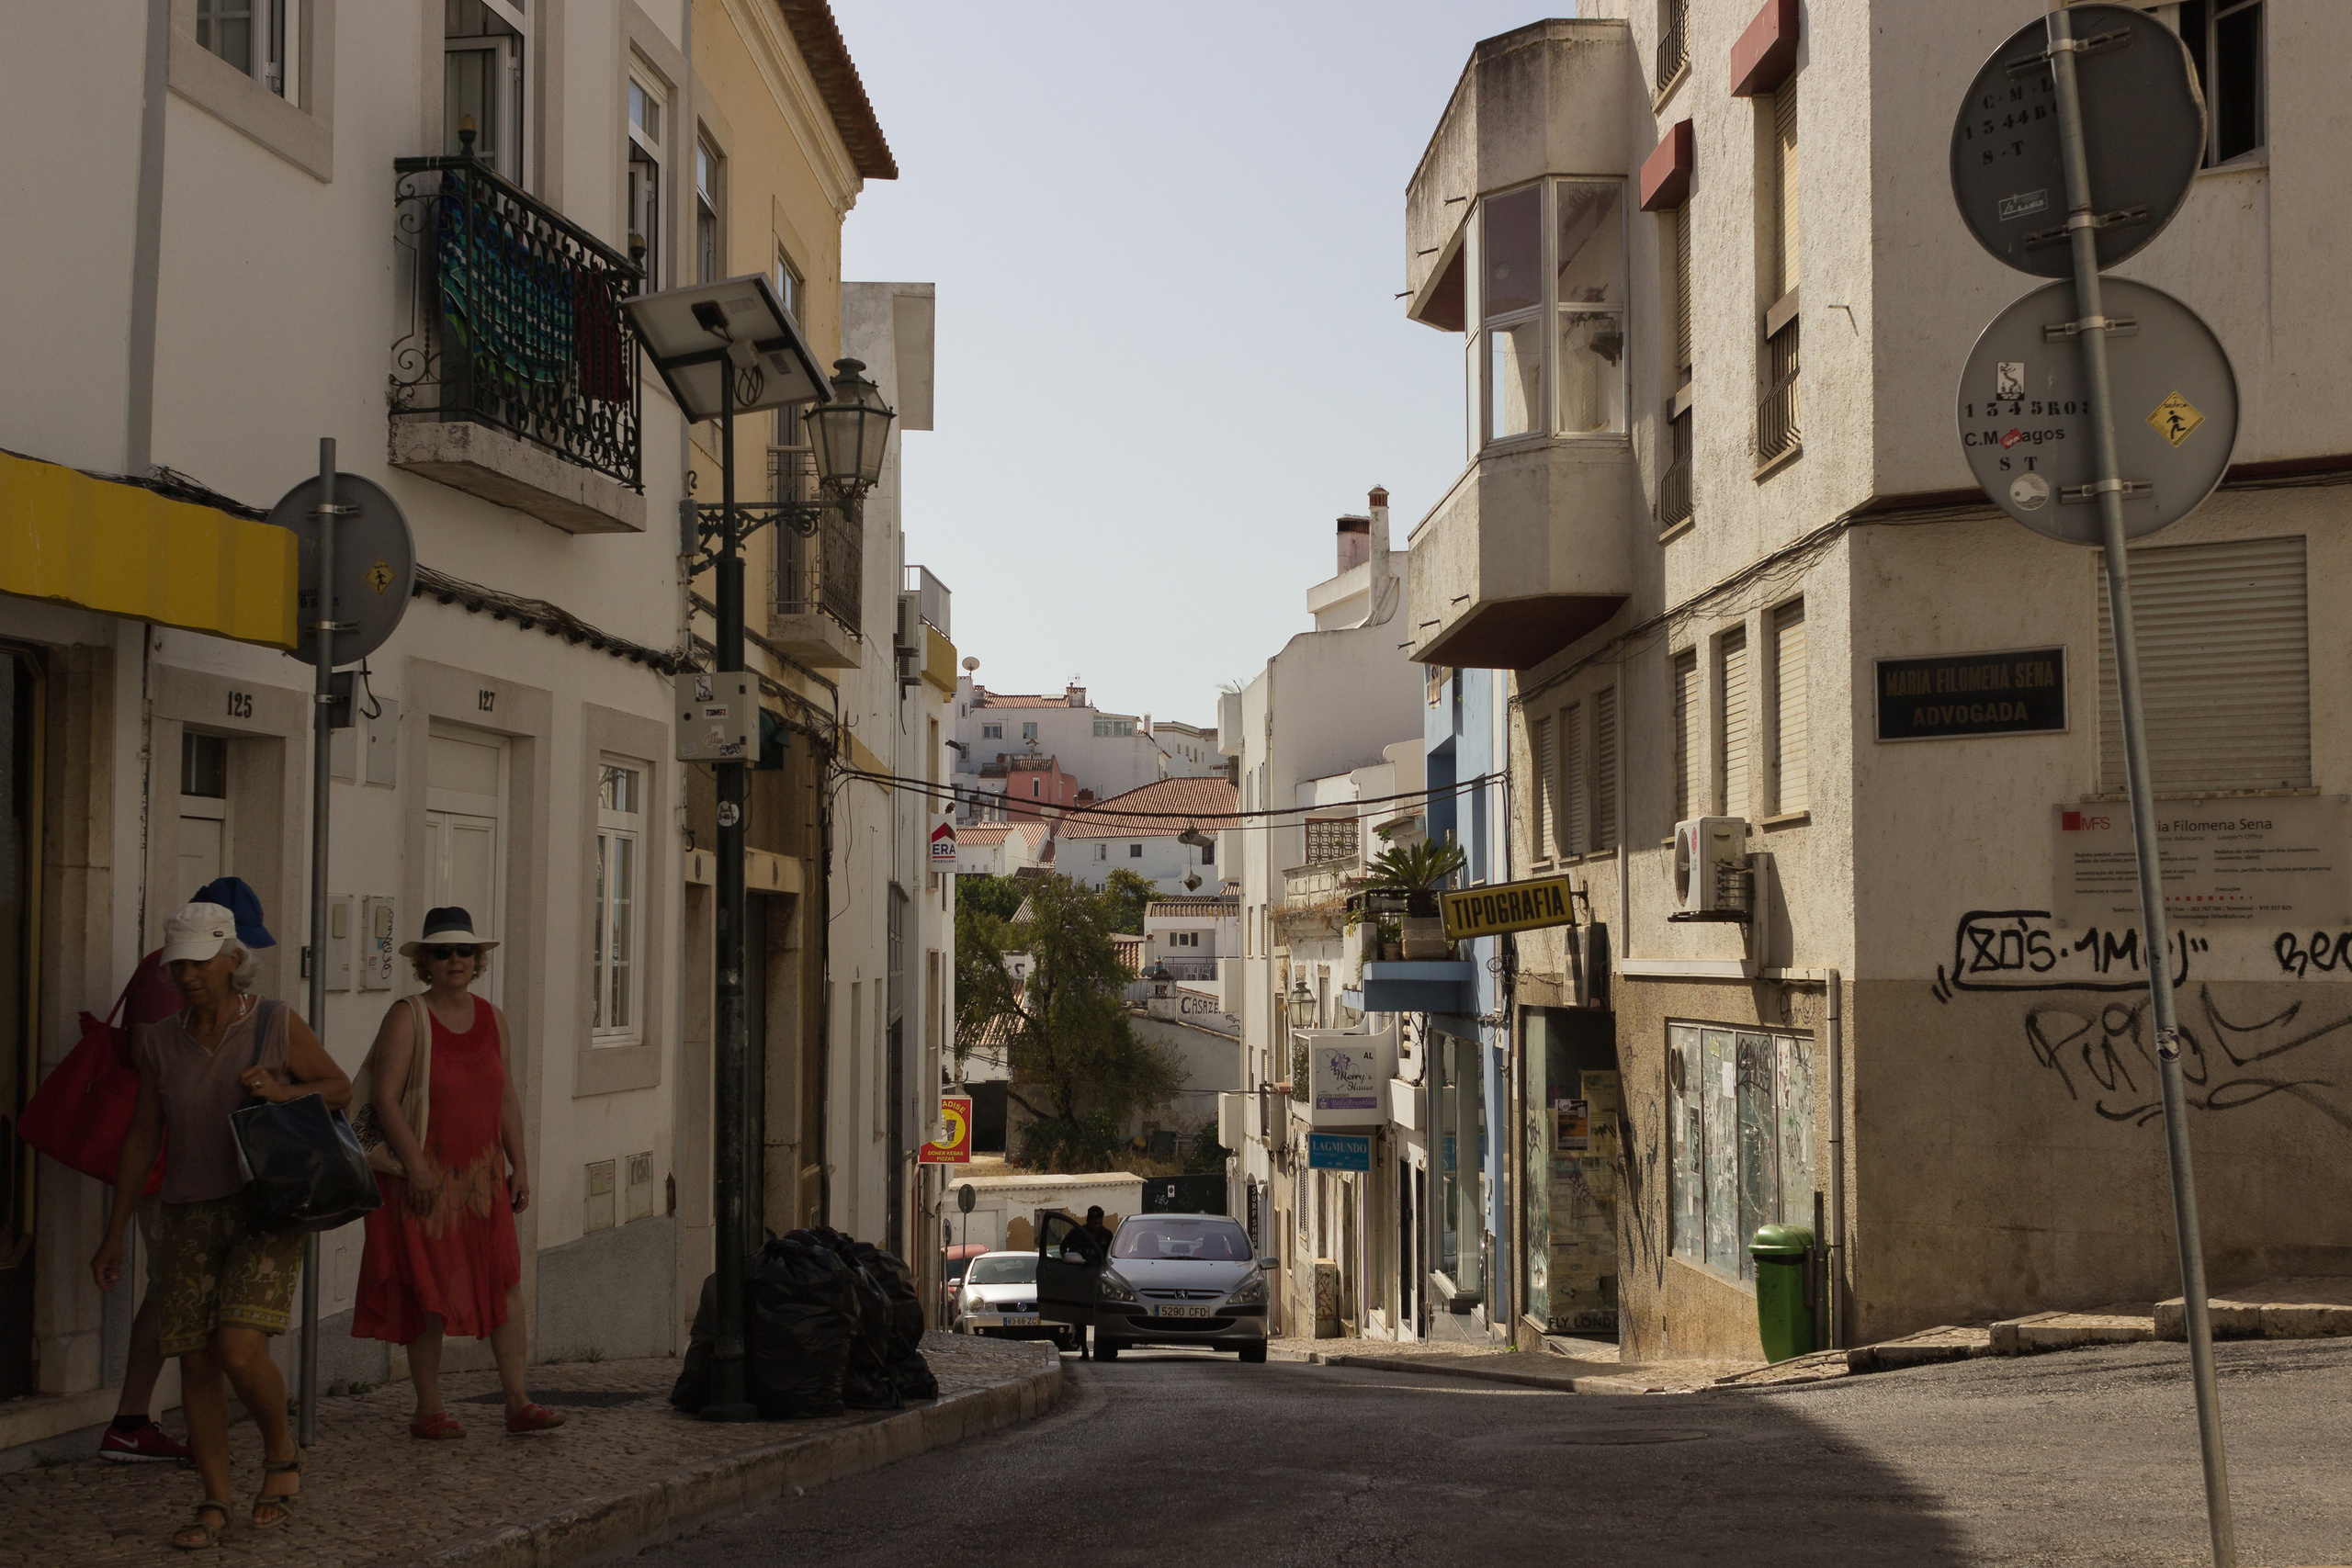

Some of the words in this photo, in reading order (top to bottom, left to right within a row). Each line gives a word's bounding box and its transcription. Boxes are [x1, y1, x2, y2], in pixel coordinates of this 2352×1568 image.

[1885, 669, 1932, 696] MARIA
[1937, 663, 2010, 694] FILOMENA
[2015, 660, 2054, 688] SENA
[227, 690, 253, 719] 125
[478, 689, 496, 713] 127
[1913, 701, 2029, 727] ADVOGADA
[2082, 816, 2110, 830] MFS
[2174, 819, 2235, 832] Filomena
[2240, 818, 2272, 830] Sena
[933, 843, 956, 855] ERA
[1452, 886, 1566, 930] TIPOGRAFIA
[1333, 1069, 1373, 1084] Merry's
[942, 1100, 967, 1114] ADISE
[1313, 1140, 1367, 1154] LAGMUNDO
[1161, 1306, 1185, 1316] 5290
[1189, 1307, 1206, 1317] CFD
[1549, 1317, 1567, 1328] FLY
